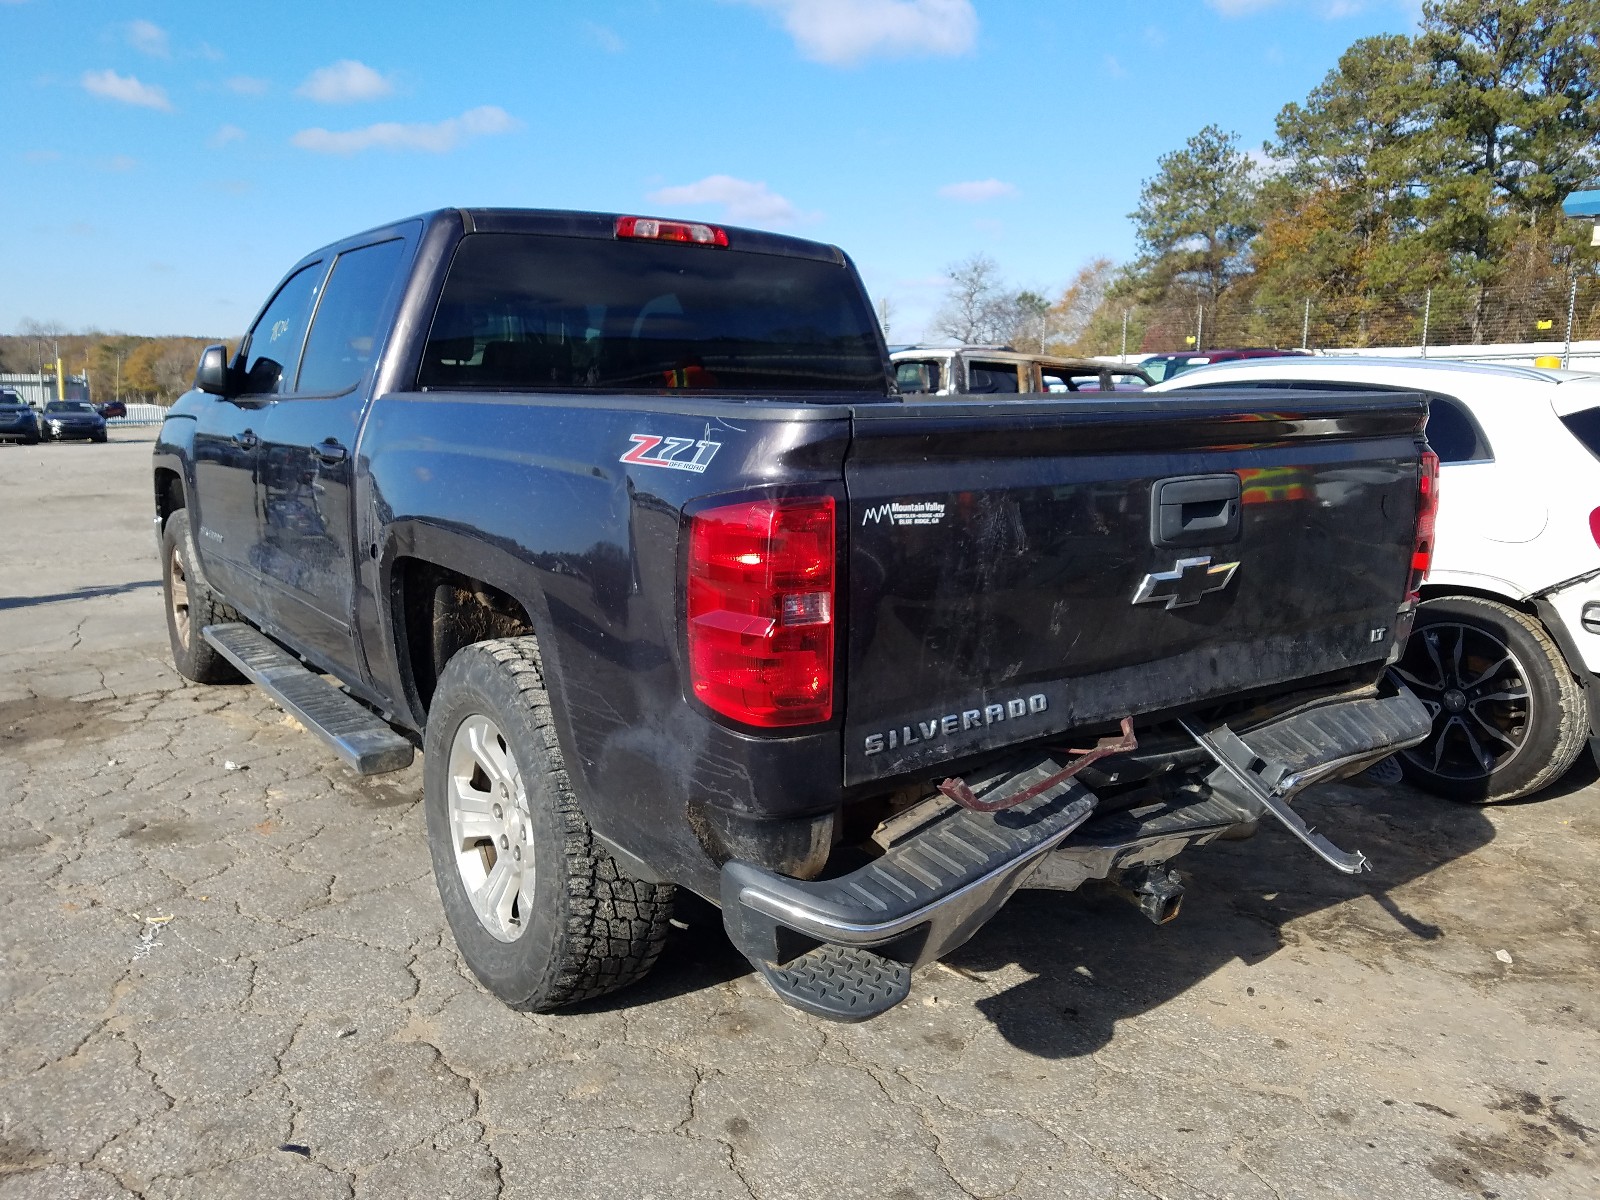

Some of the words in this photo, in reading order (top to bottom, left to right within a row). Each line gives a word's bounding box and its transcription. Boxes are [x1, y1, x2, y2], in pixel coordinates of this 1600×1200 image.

[619, 434, 721, 466] Z71
[892, 503, 925, 512] Mountain
[925, 502, 945, 513] Valley
[864, 693, 1048, 756] SILVERADO
